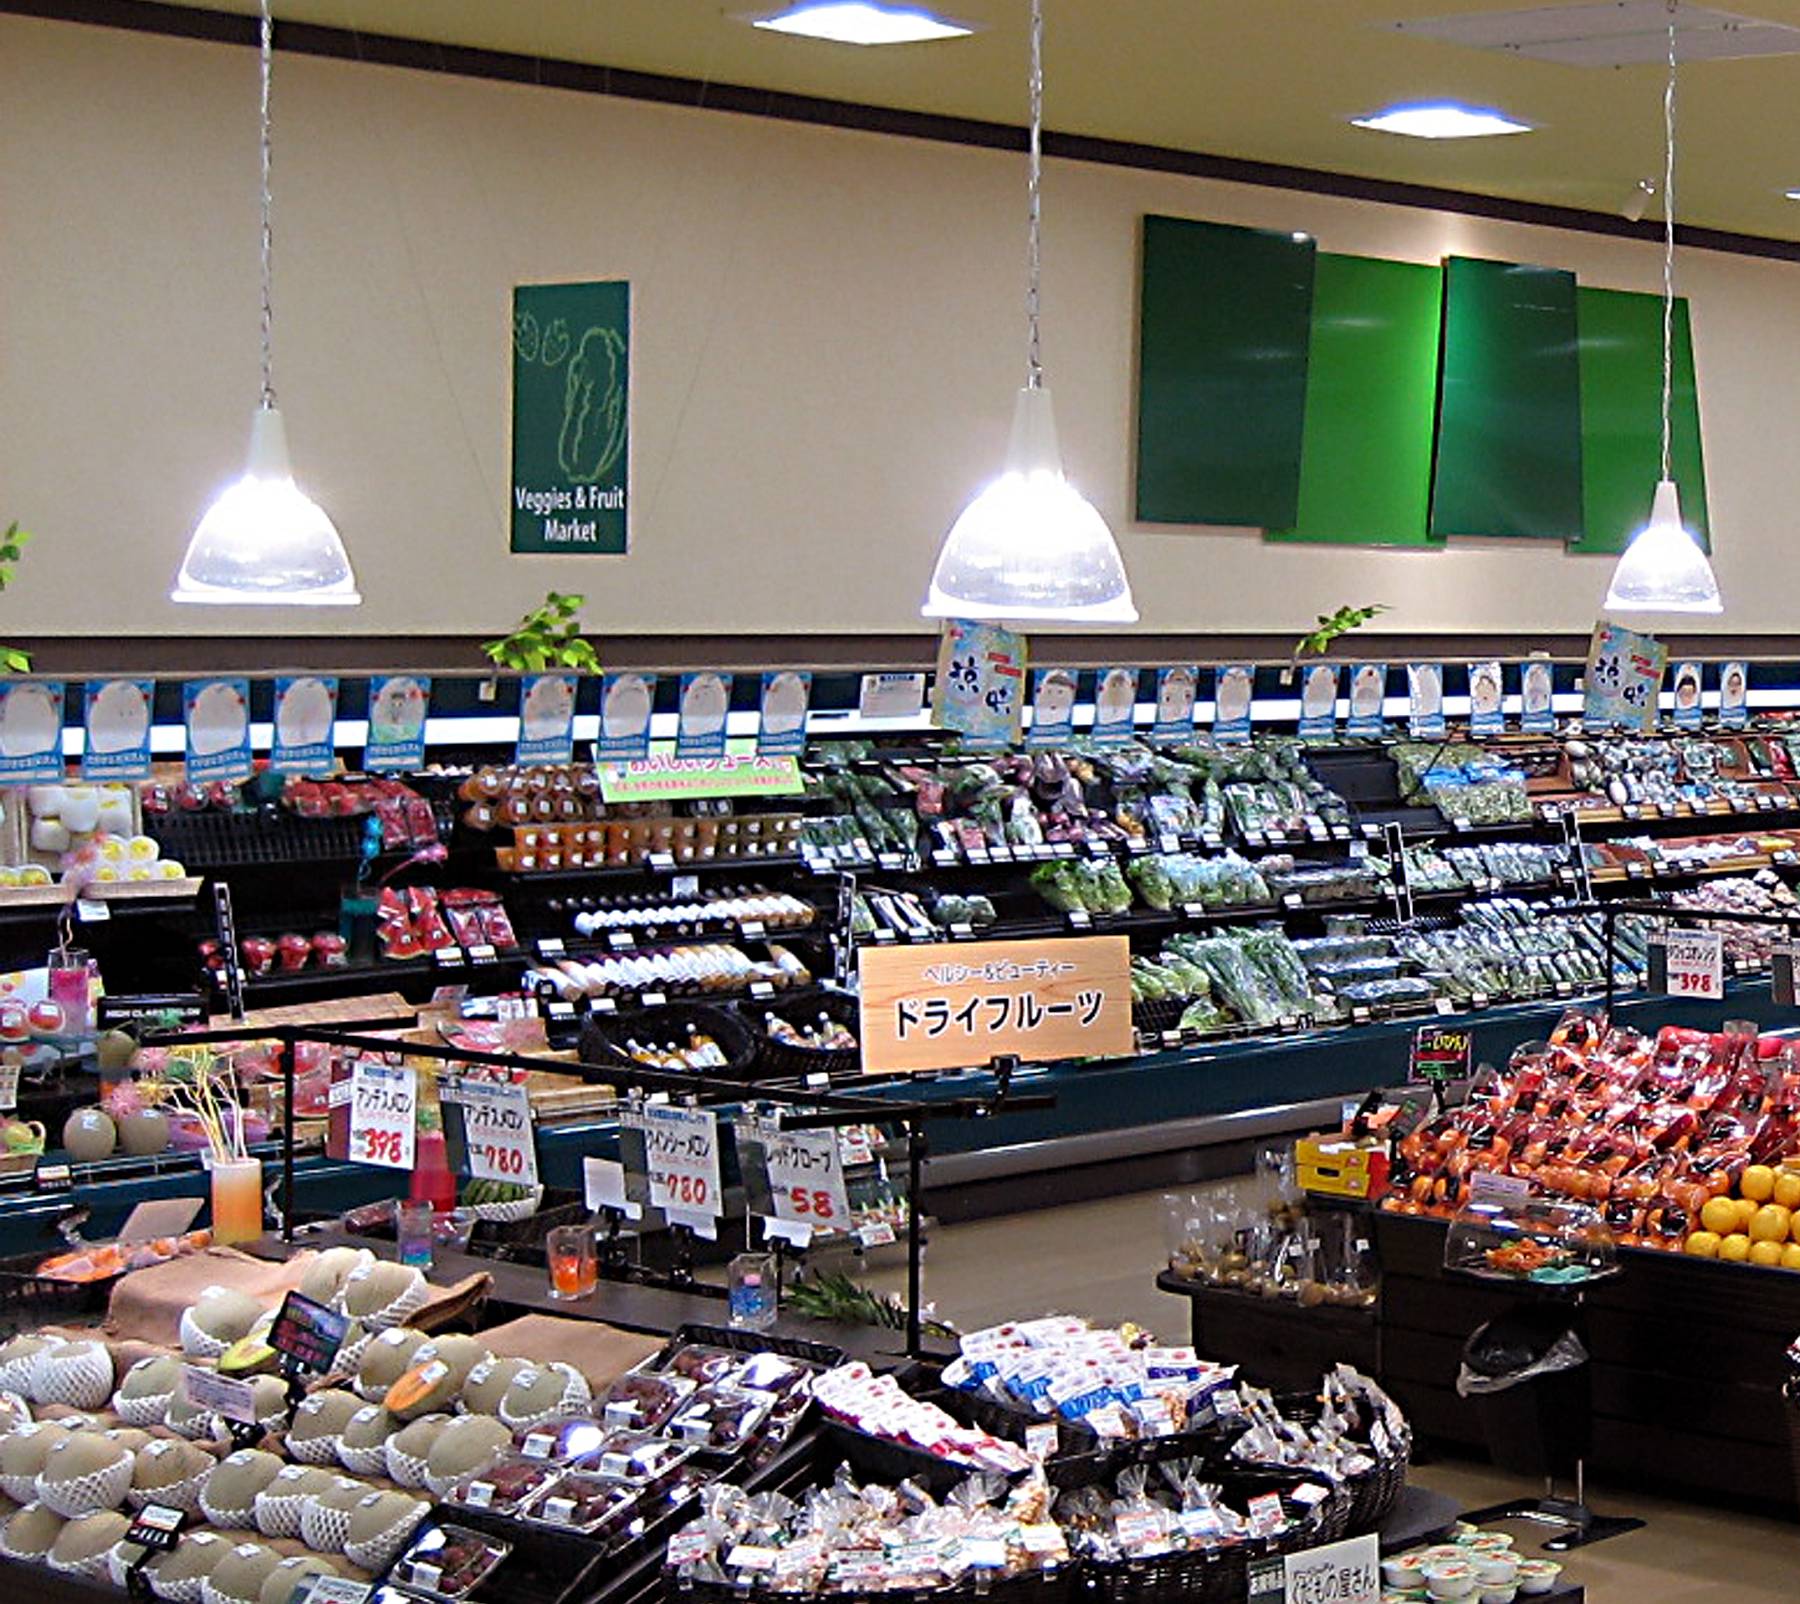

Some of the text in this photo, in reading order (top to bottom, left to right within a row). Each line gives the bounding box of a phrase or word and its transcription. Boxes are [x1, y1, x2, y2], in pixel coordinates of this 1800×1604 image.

[515, 485, 625, 515] Veggies & Fruit
[544, 518, 598, 541] Market
[922, 957, 1078, 985] ヘルシー&ビューティー
[1680, 972, 1712, 993] 398
[895, 987, 1104, 1041] ドライフルーツ
[364, 1127, 403, 1164] 398
[484, 1143, 524, 1175] 780
[665, 1173, 708, 1206] 780
[790, 1185, 834, 1219] 58
